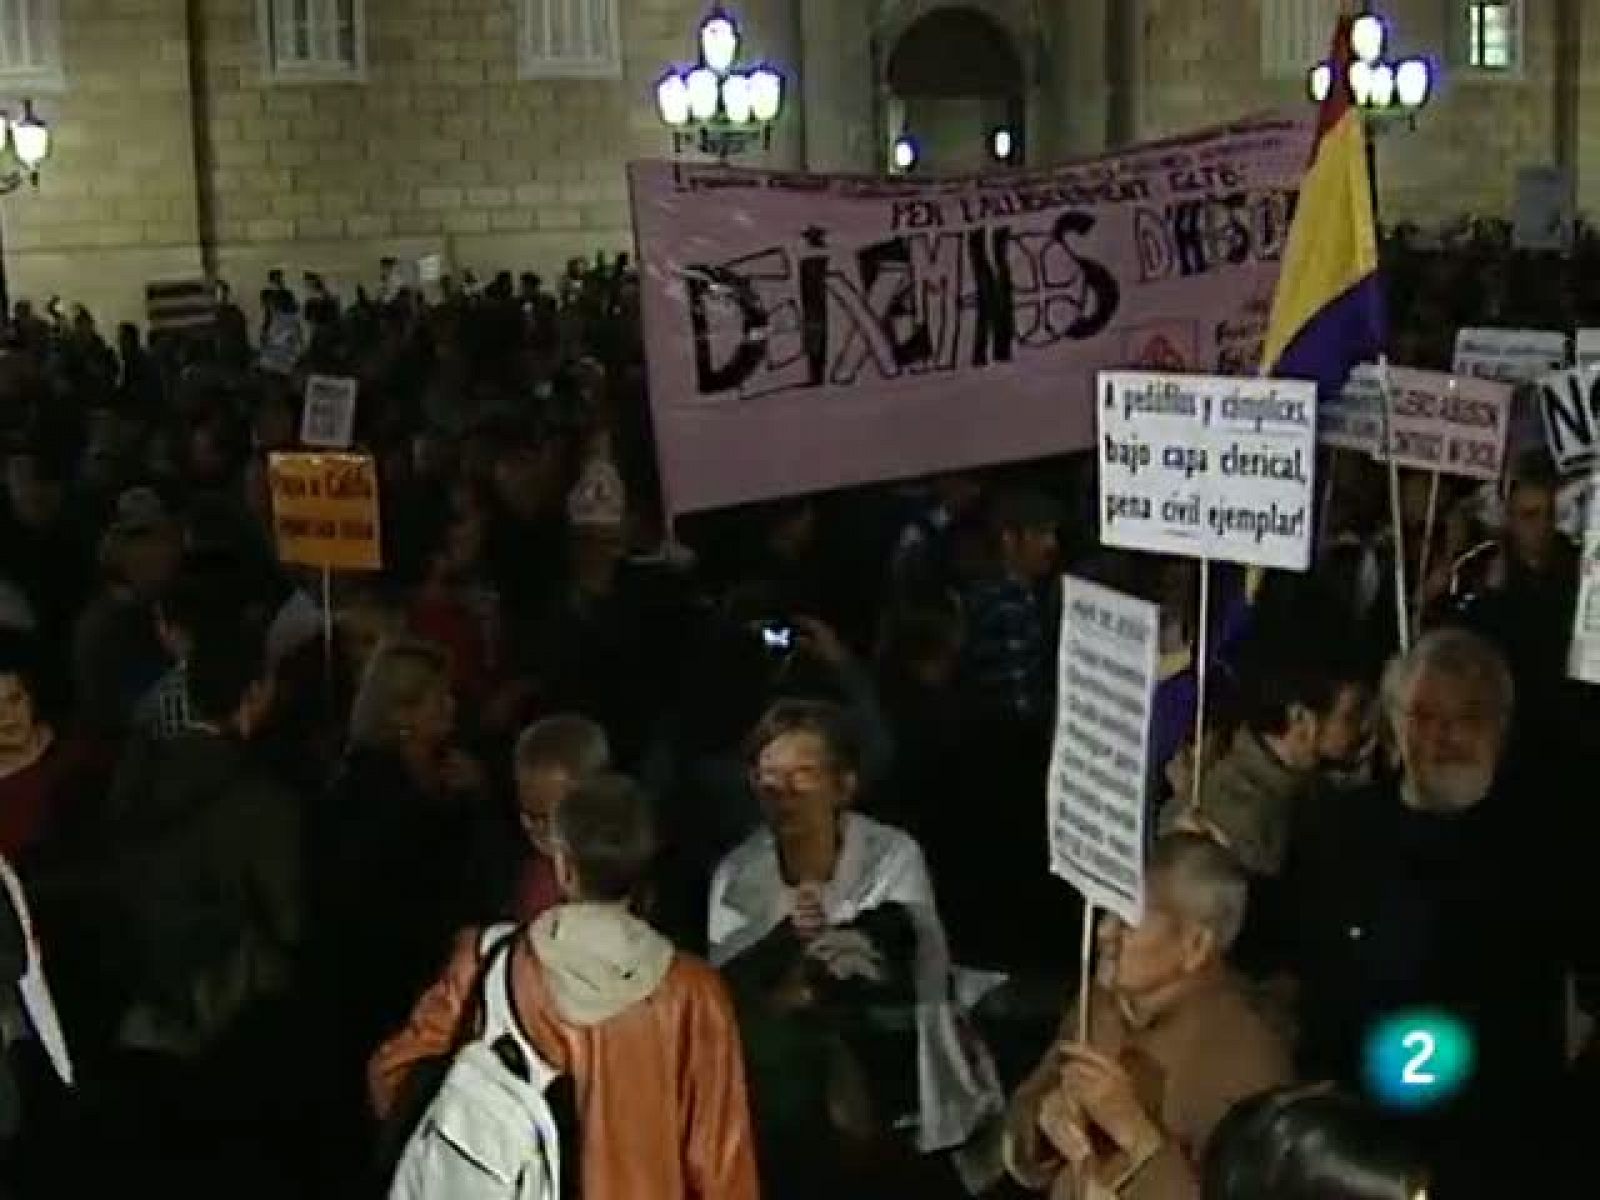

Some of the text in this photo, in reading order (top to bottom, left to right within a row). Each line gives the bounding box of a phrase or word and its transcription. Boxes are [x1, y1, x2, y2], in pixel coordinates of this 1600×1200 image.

[1105, 434, 1151, 475] bajo
[1163, 447, 1209, 479] capa
[1106, 495, 1152, 525] pena
[1162, 491, 1201, 526] civil
